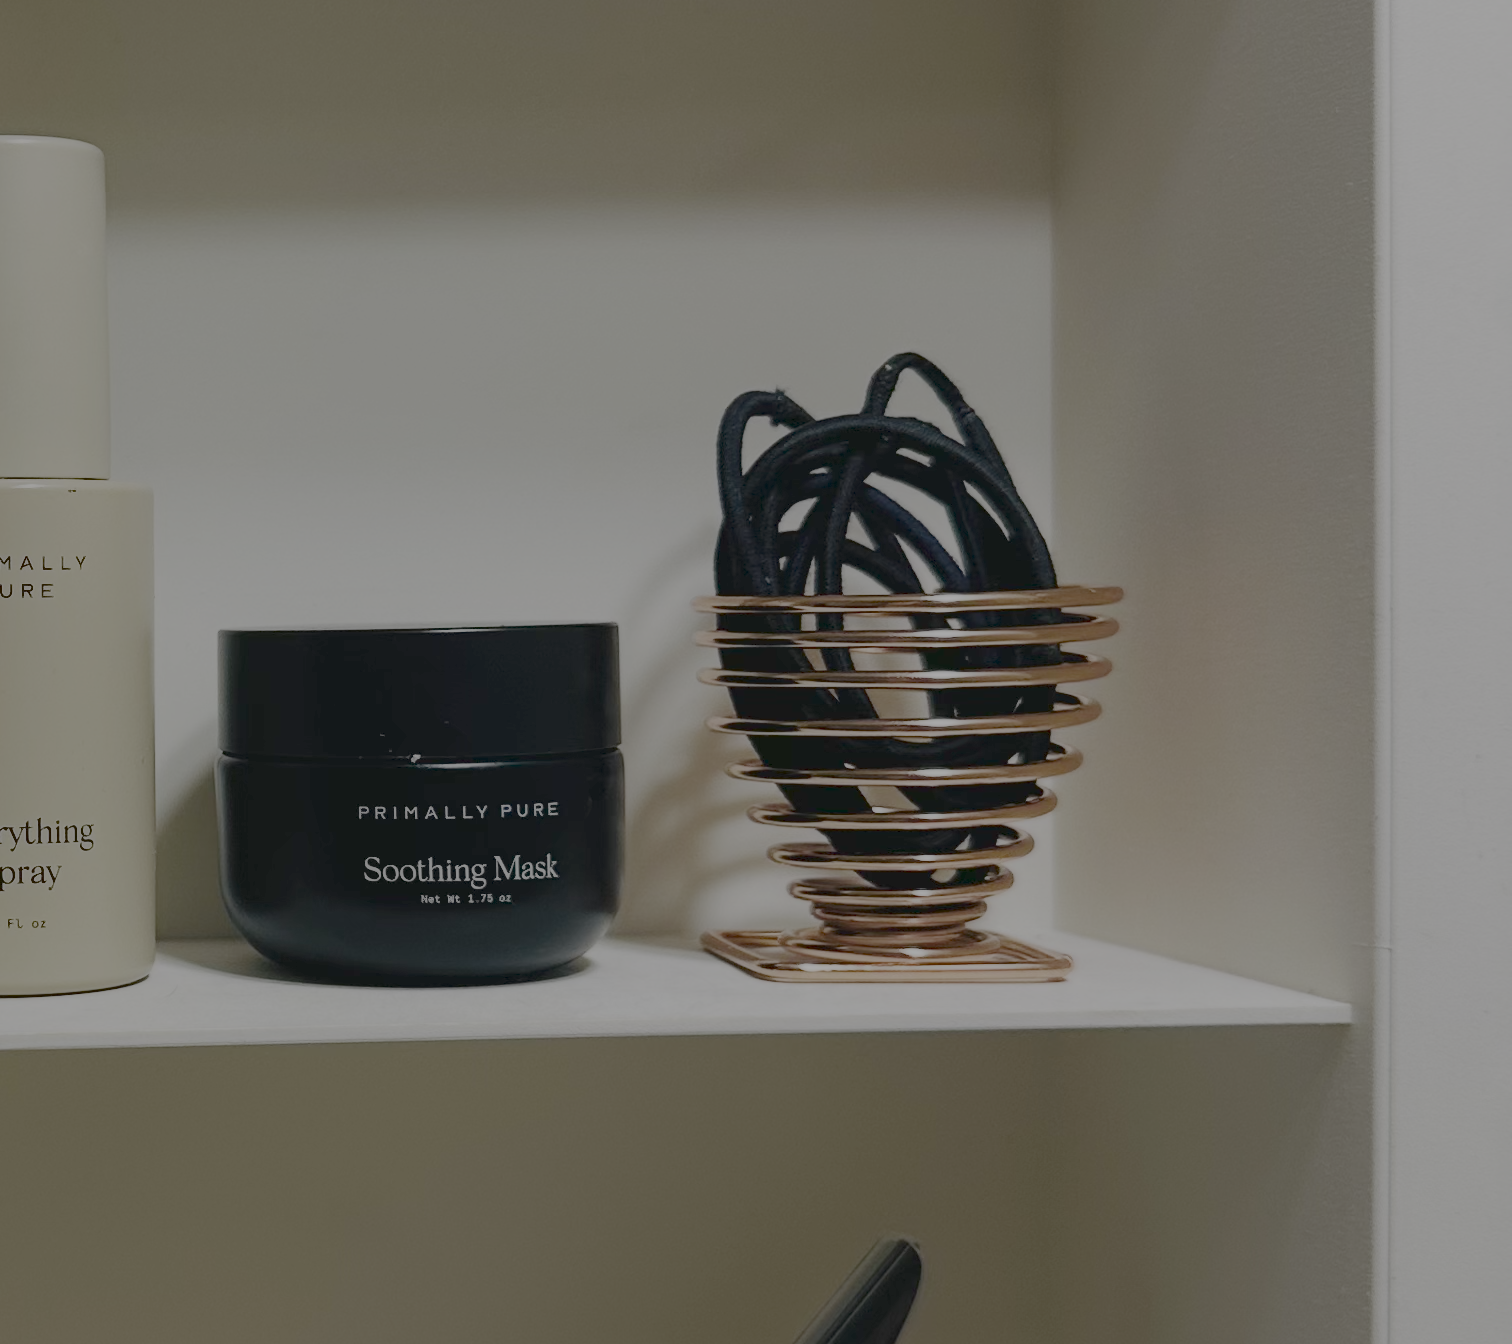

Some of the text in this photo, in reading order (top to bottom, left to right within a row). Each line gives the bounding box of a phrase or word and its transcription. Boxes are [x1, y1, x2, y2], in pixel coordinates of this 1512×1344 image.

[358, 801, 559, 820] PRIMALLY PURE
[363, 852, 560, 890] Soothing Mask
[420, 893, 512, 904] Net Wt 1.75 oz
[7, 918, 23, 929] Fl
[31, 919, 46, 929] oz
